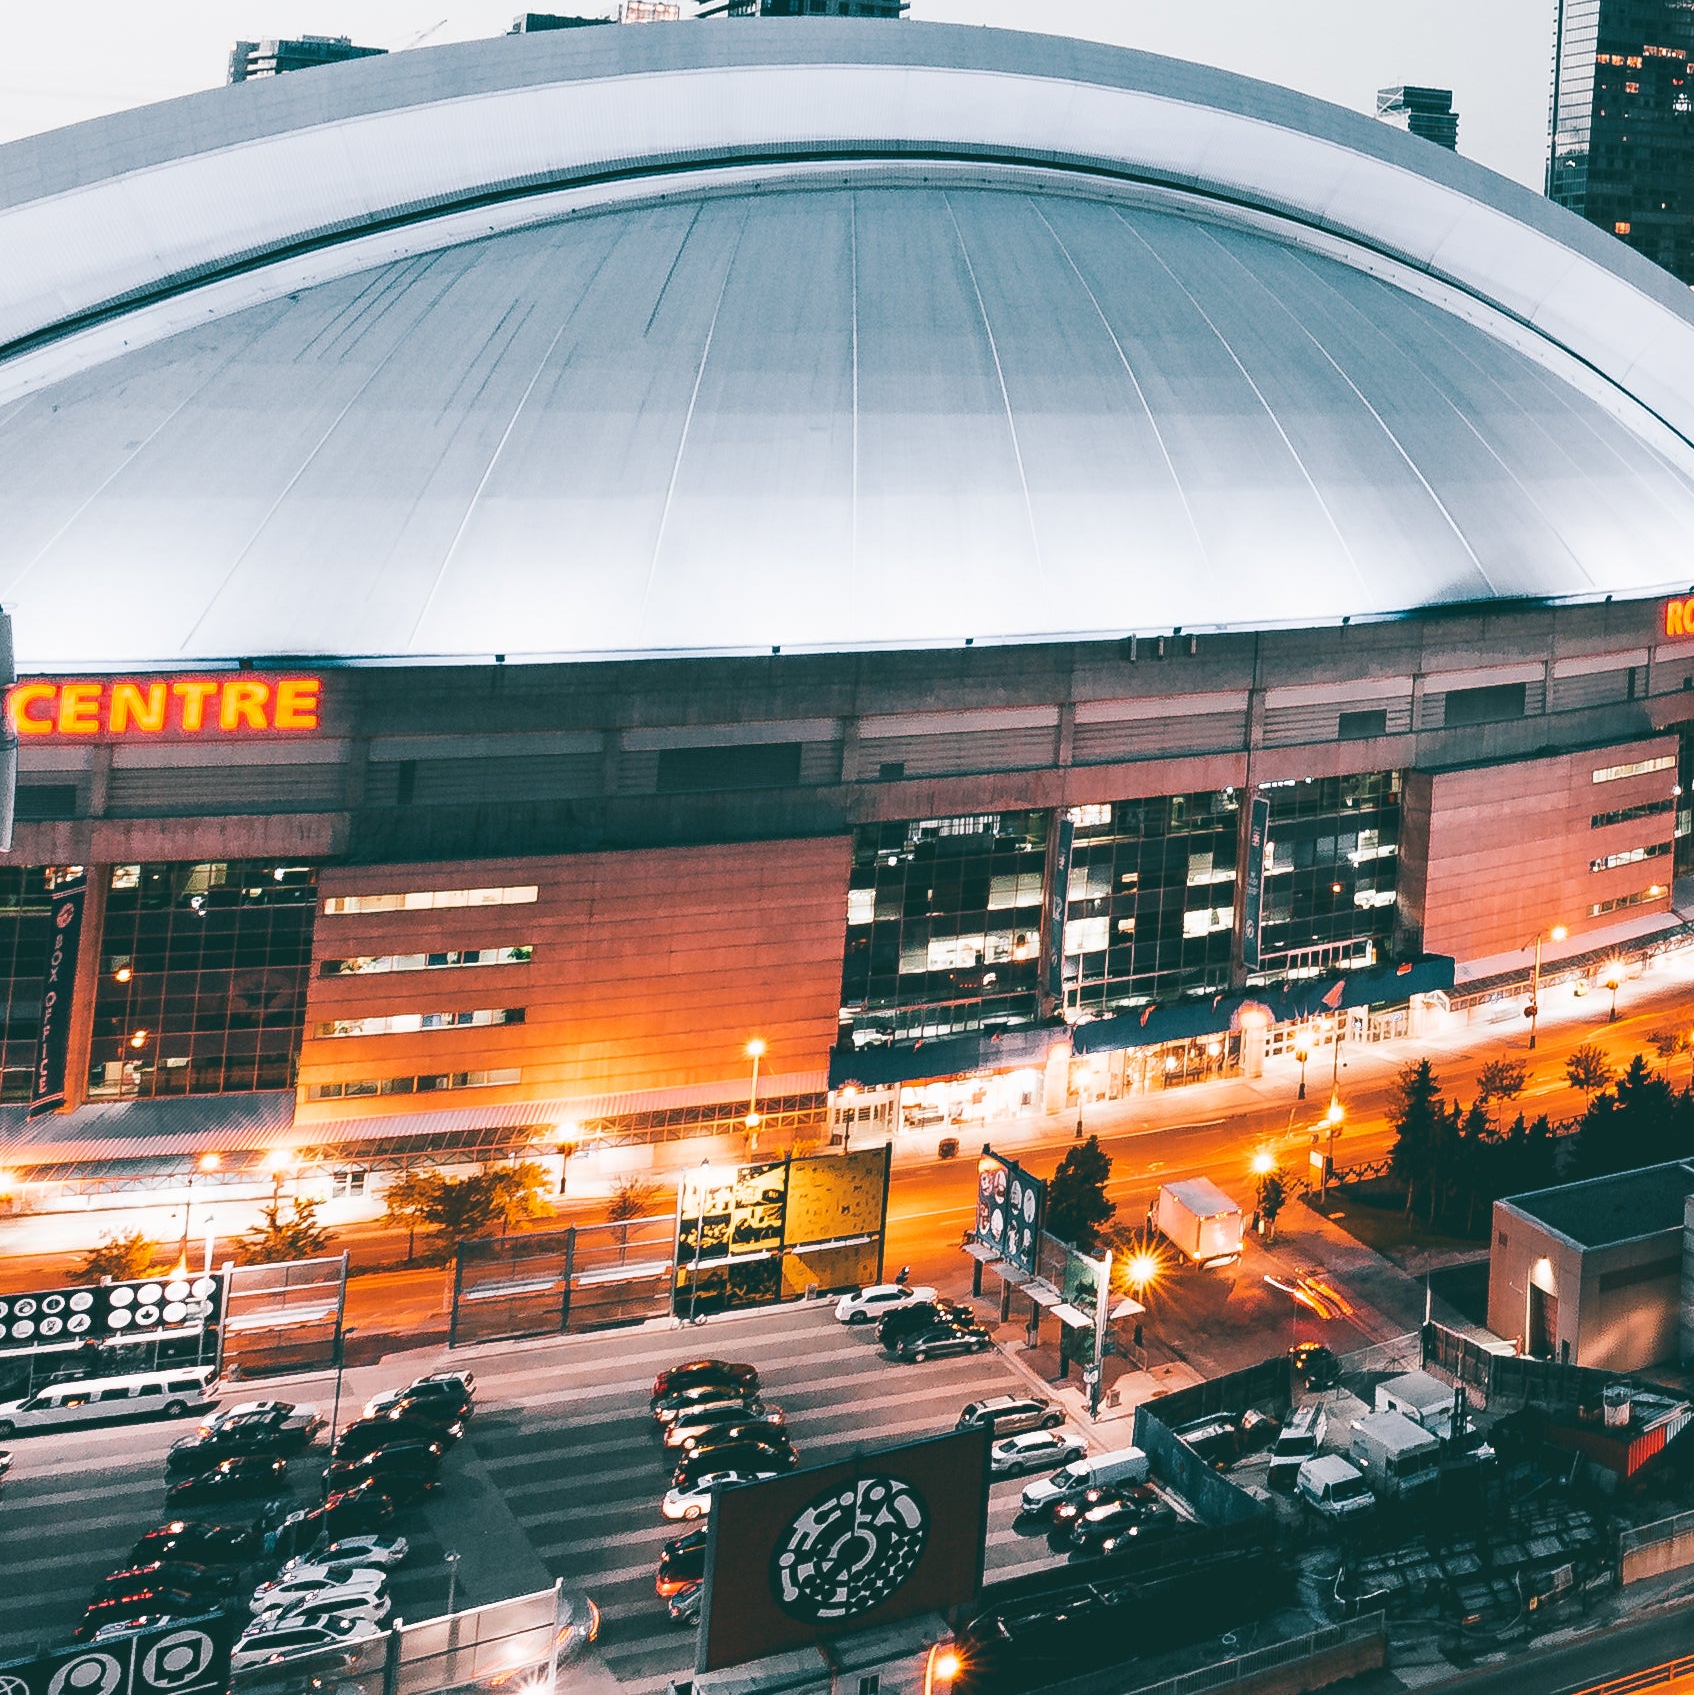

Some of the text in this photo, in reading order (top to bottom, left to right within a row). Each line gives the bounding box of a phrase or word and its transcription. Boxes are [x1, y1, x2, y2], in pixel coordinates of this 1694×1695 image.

[9, 679, 320, 733] CENTRE
[38, 932, 64, 1094] BOX OFFICE
